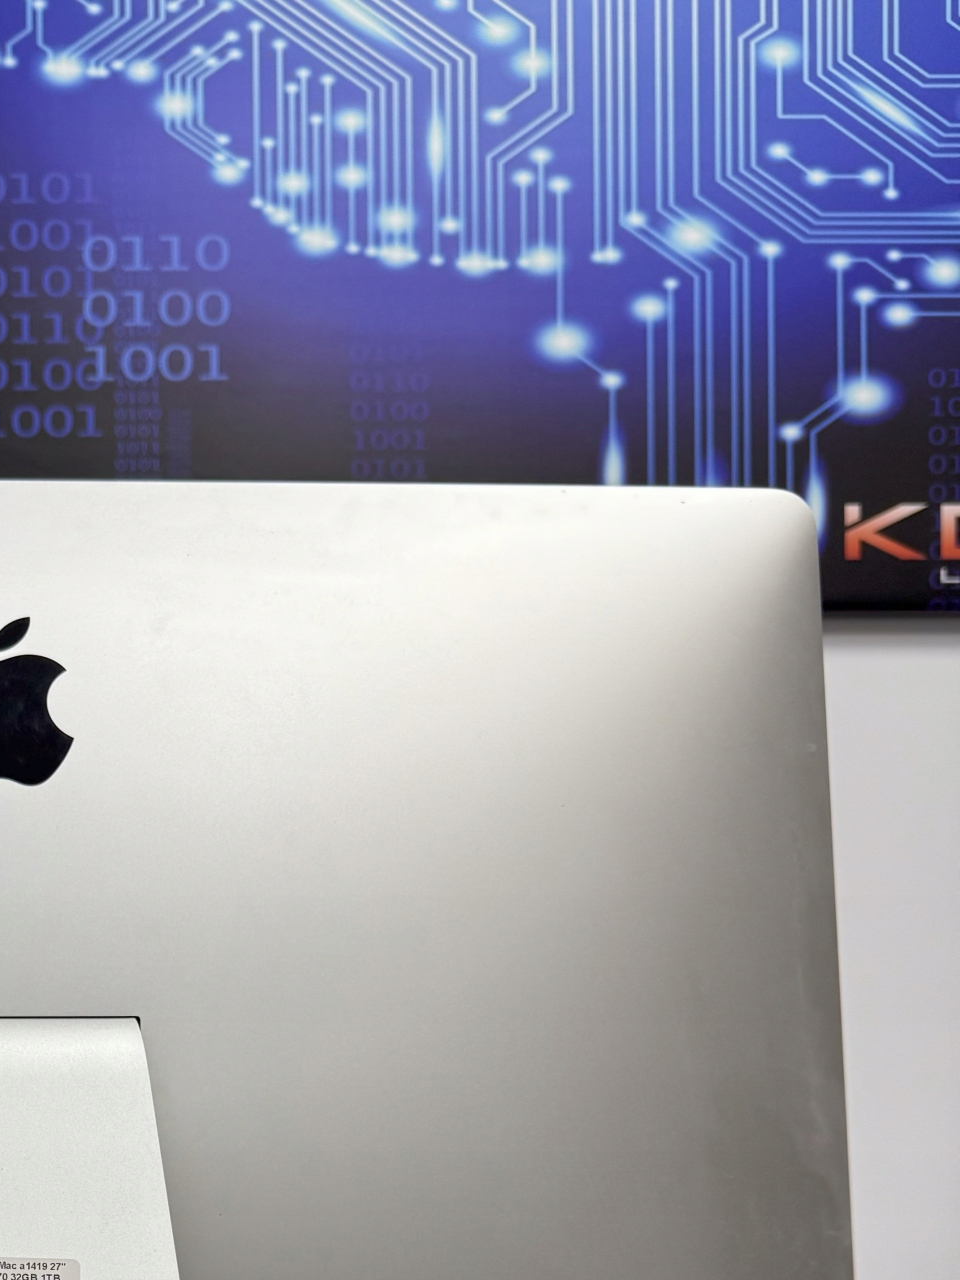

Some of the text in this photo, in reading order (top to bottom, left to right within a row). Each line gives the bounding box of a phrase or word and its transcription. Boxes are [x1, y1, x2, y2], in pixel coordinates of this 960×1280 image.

[81, 235, 231, 272] 0110
[82, 290, 232, 327] 0100
[84, 344, 229, 382] 1001
[349, 370, 430, 393] 0110
[349, 399, 430, 422] 0100
[353, 428, 427, 451] 1001
[350, 456, 427, 478] 0101
[843, 502, 960, 562] K
[19, 1262, 48, 1270] a1419
